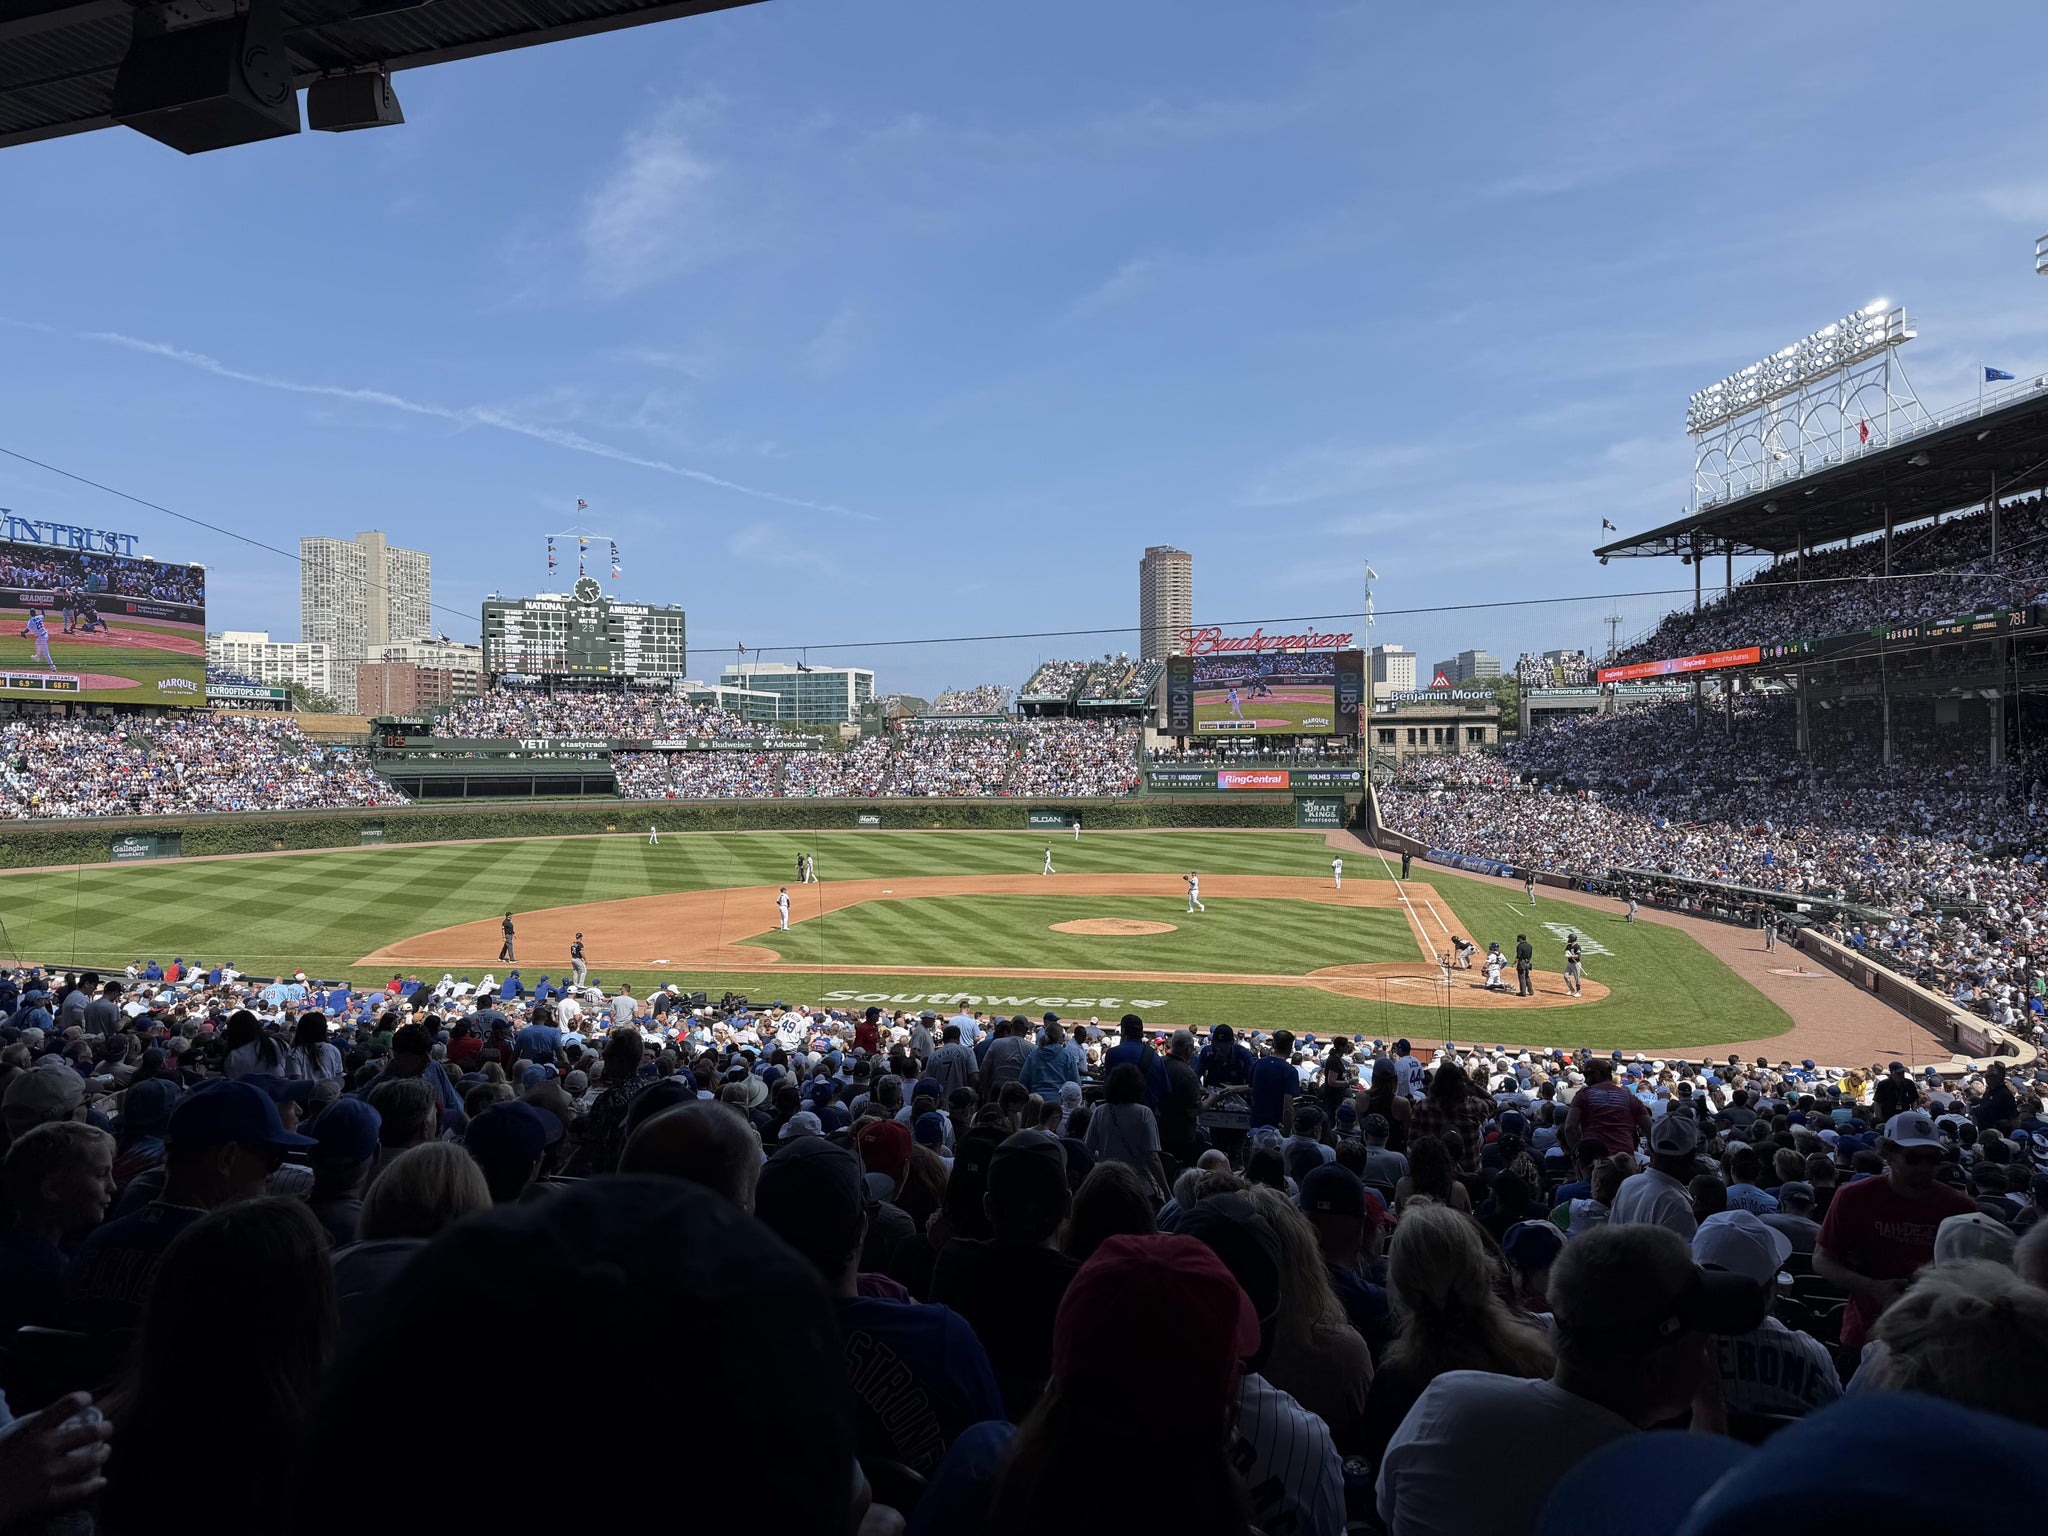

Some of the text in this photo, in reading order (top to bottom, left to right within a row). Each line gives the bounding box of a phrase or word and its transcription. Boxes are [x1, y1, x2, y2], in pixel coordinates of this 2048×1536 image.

[20, 594, 55, 603] GRAINGER
[525, 601, 567, 611] NATIONAL
[609, 606, 649, 615] AMERICAN
[2008, 612, 2020, 626] 78
[582, 624, 595, 632] 29
[1972, 622, 1997, 630] CURVEBALL
[1914, 628, 1918, 636] 1
[1178, 626, 1353, 656] Budweiser
[158, 678, 198, 692] MARQUEE
[1172, 664, 1189, 730] CHICAGO
[1340, 672, 1357, 714] CUBS
[1391, 689, 1493, 703] Benjamin Moore
[401, 716, 424, 724] Mobile
[1302, 718, 1330, 726] MARQUEE
[518, 740, 549, 749] YETI
[565, 740, 608, 749] tastytrade
[773, 740, 808, 748] Advocate
[1224, 774, 1282, 785] RingCentral
[1304, 804, 1337, 813] DRAFT
[112, 843, 150, 854] Gallagher
[267, 990, 275, 999] 29
[821, 990, 1134, 1009] Southwest
[782, 1020, 796, 1034] 49
[942, 1060, 952, 1081] 7
[1410, 1069, 1420, 1086] 44
